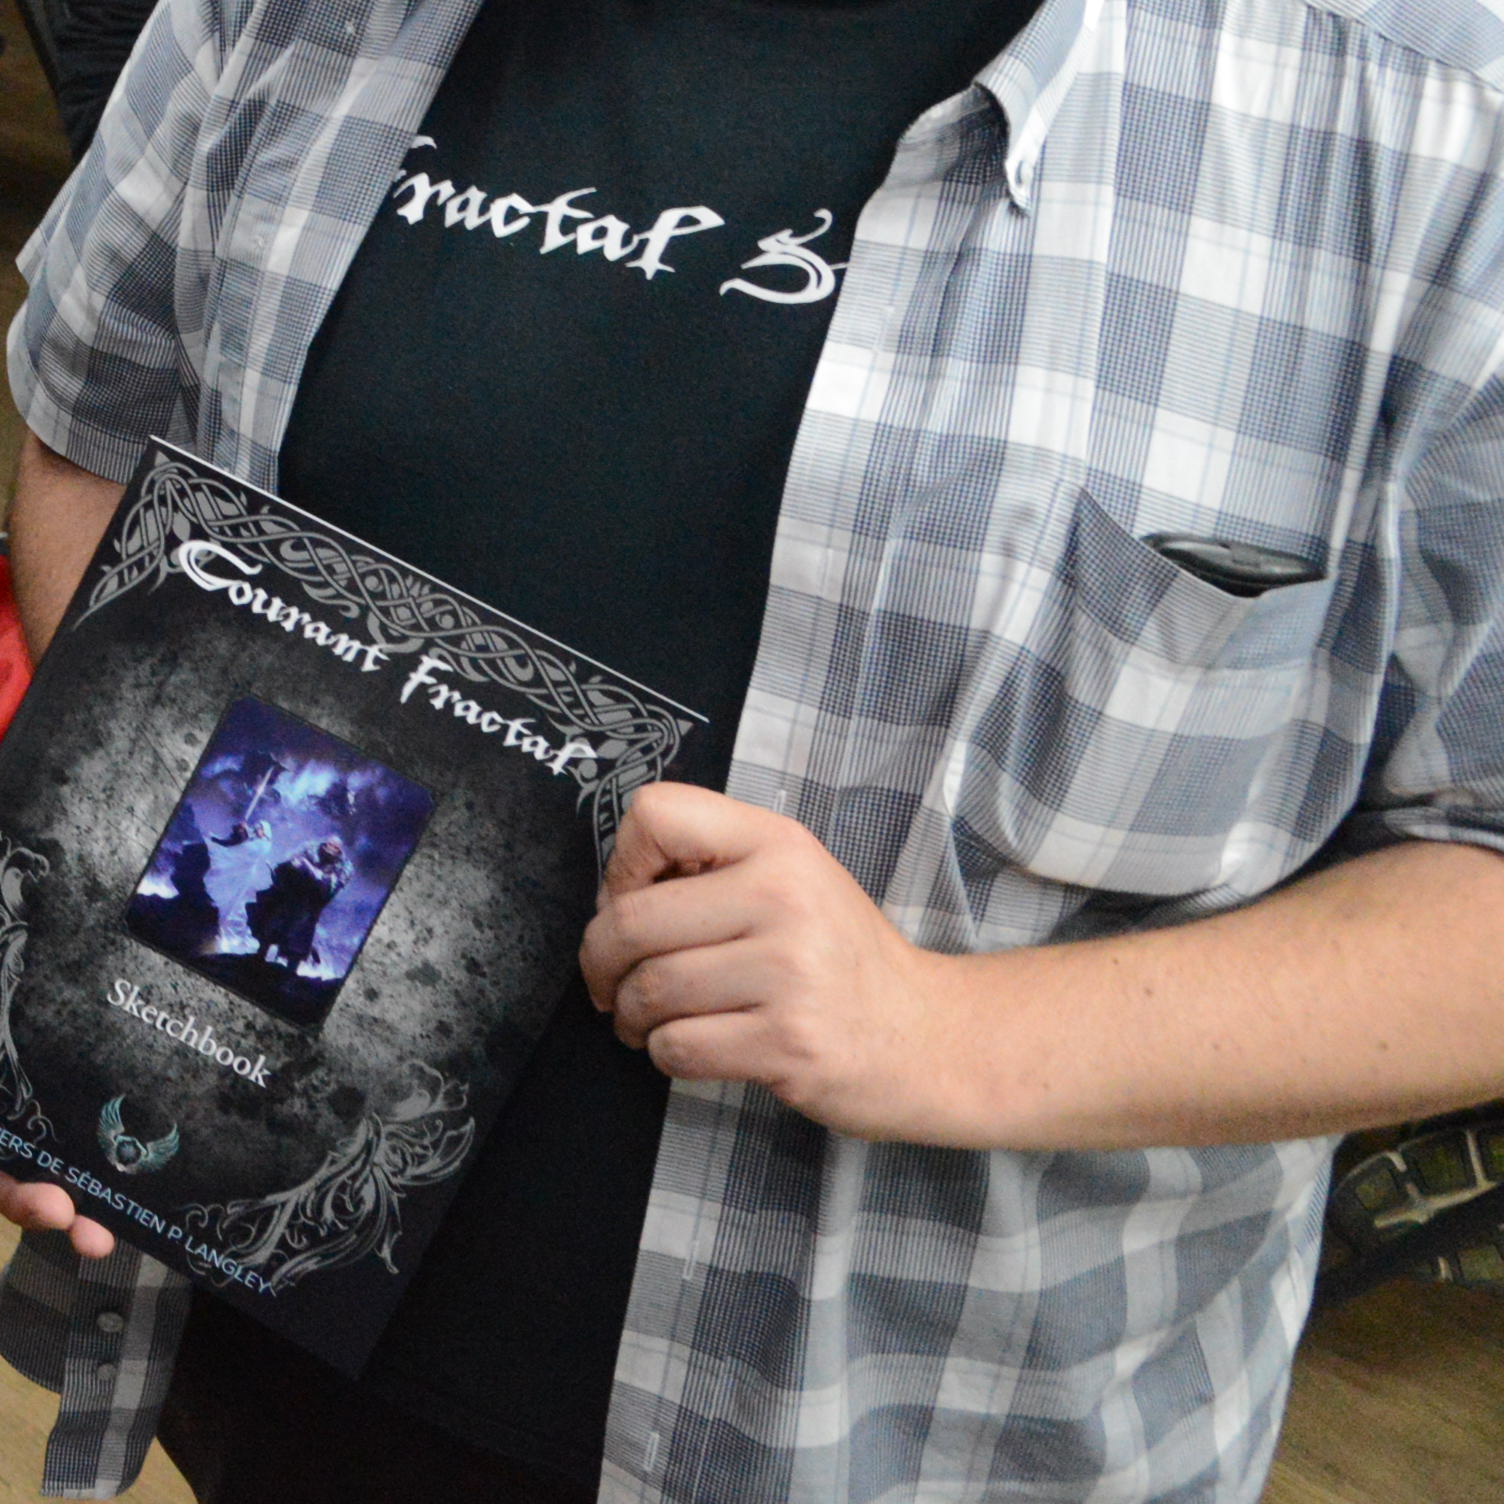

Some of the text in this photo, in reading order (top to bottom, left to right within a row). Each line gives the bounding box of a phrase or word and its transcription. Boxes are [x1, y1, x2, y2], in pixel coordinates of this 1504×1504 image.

[392, 136, 726, 281] ractal
[177, 539, 599, 777] Courant Fractal
[105, 976, 273, 1089] Sketchbook
[36, 1149, 63, 1174] DE
[64, 1166, 166, 1235] SÉBASTIEN
[184, 1236, 272, 1295] LANGLEY
